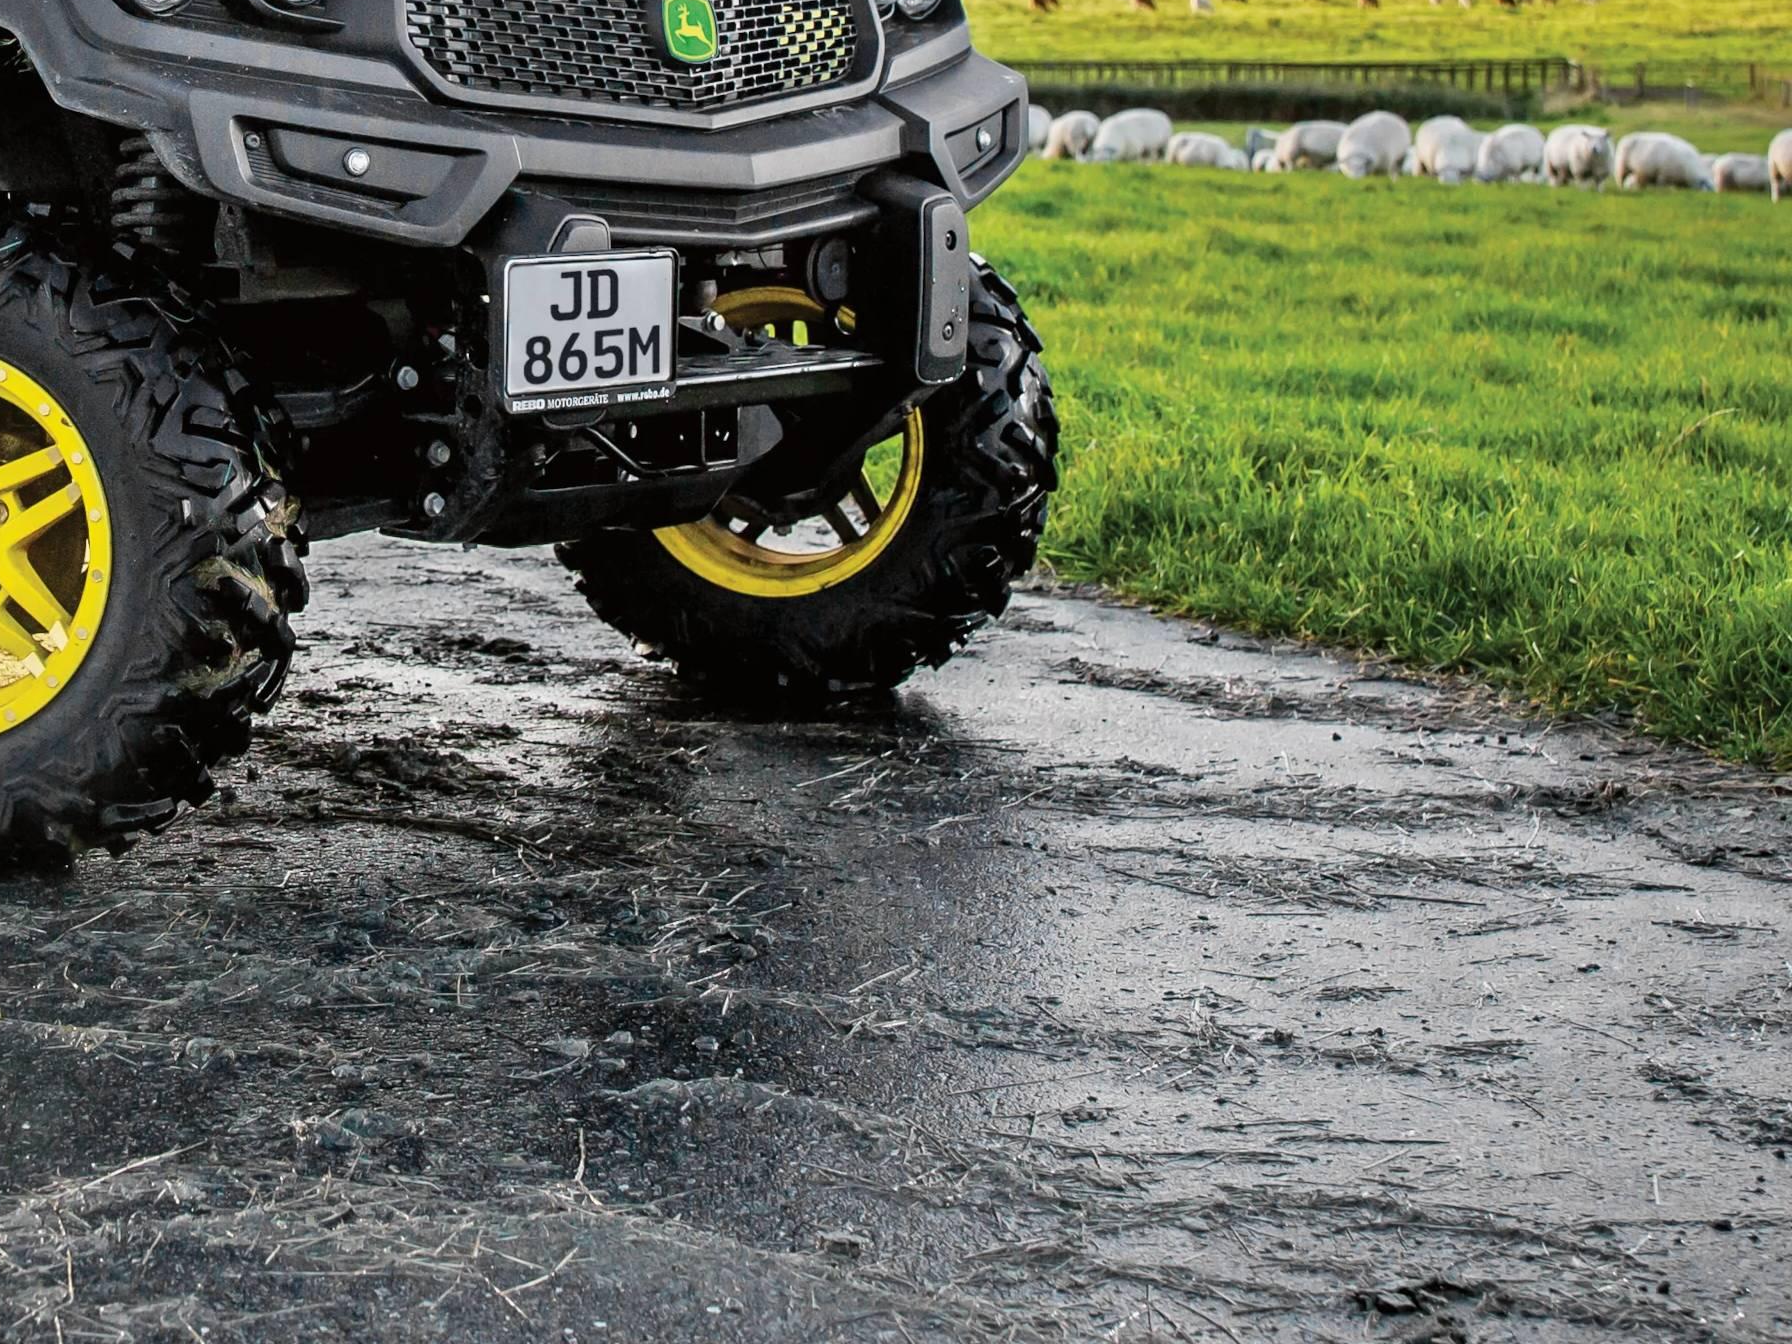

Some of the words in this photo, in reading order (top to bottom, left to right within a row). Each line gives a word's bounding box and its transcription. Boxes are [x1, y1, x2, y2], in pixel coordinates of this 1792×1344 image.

[550, 268, 619, 321] JD
[523, 325, 661, 385] 865M
[512, 399, 546, 412] REBO
[547, 393, 609, 409] MOTORGERÄTE
